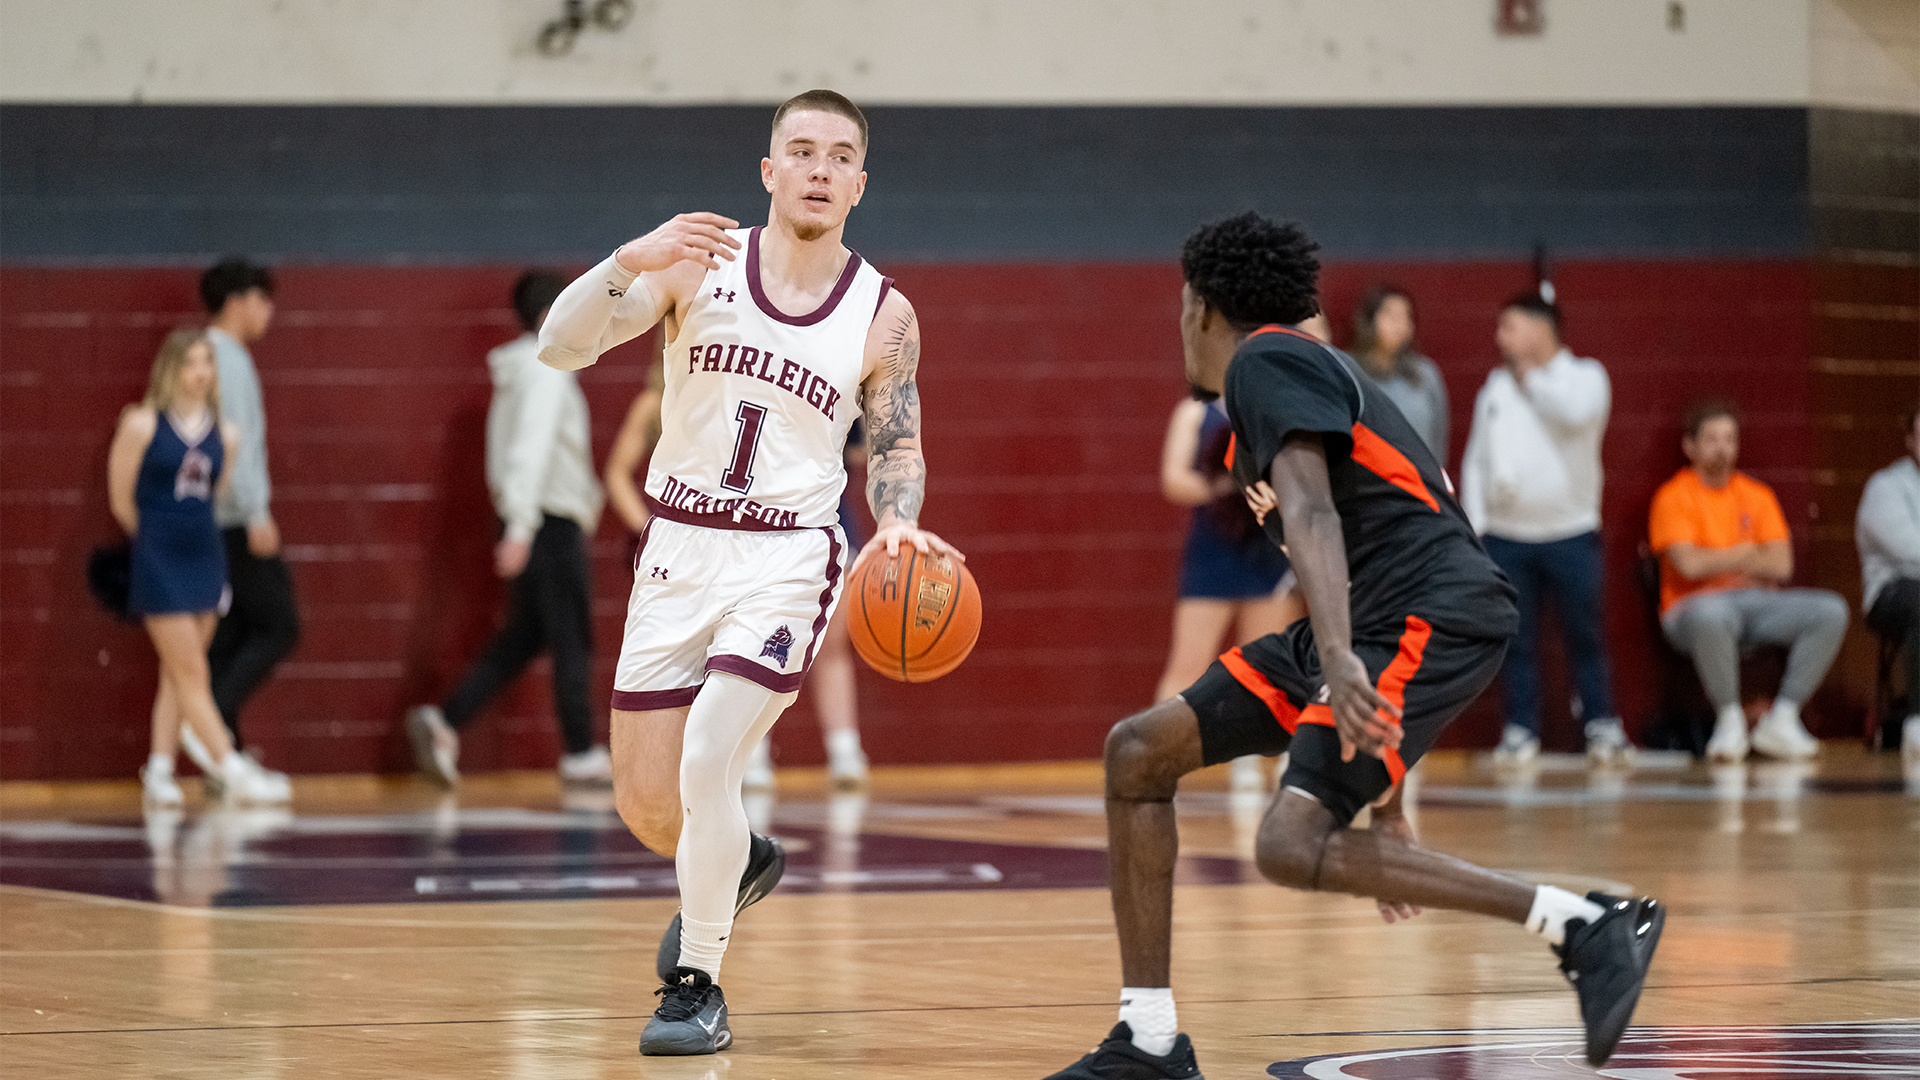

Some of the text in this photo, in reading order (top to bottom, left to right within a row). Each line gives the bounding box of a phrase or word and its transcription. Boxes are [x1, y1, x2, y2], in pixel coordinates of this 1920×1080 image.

[689, 343, 841, 422] FAIRLEIGH
[720, 400, 768, 495] 1
[659, 475, 799, 528] DICKINSON
